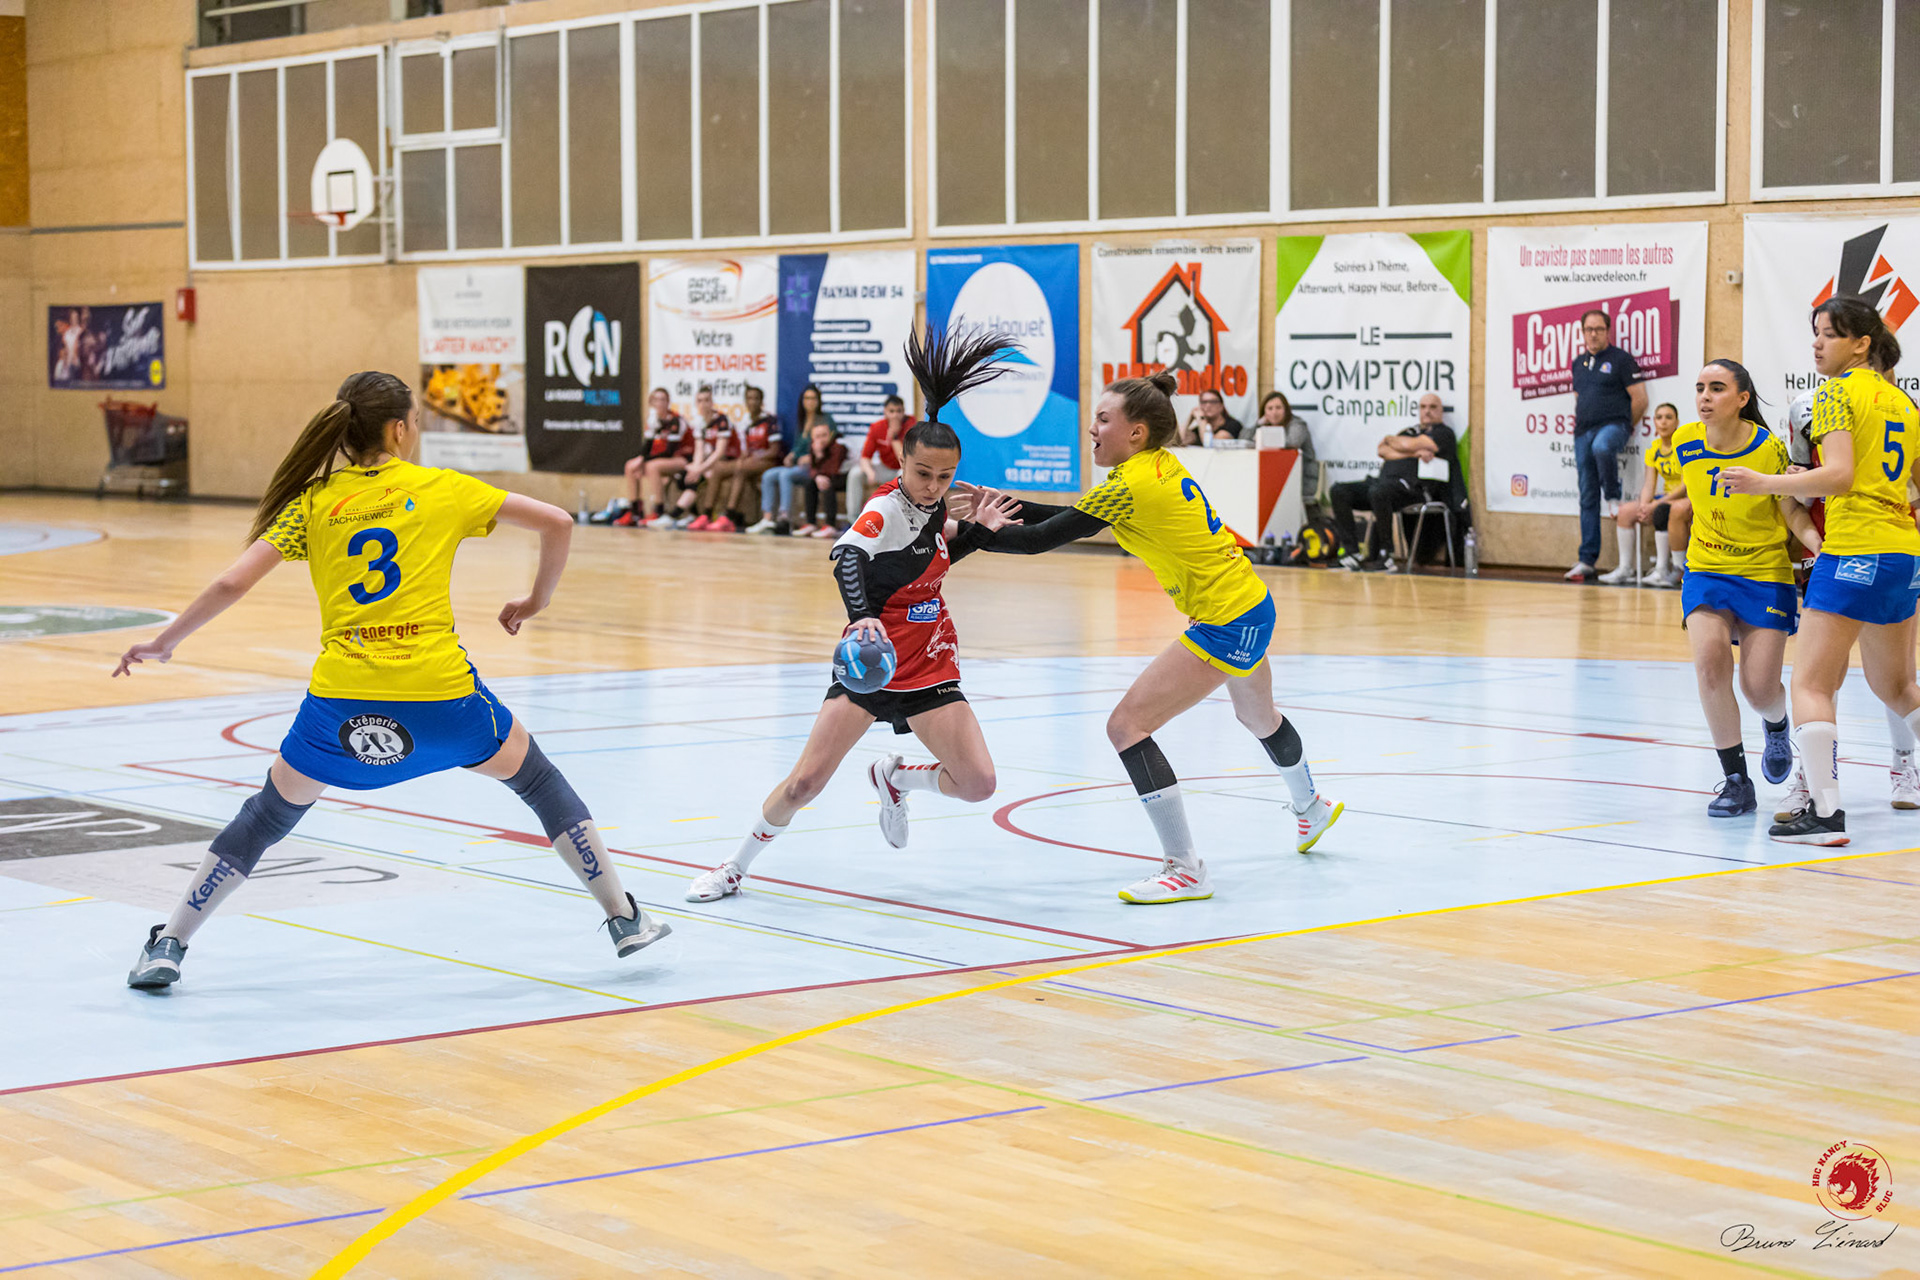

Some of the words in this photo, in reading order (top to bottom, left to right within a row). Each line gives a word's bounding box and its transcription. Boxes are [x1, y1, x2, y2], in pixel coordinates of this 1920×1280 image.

[1097, 247, 1153, 257] Construisons
[1154, 246, 1197, 256] ensemble
[1199, 246, 1222, 255] votre
[1224, 244, 1254, 254] avenir
[1520, 245, 1532, 268] Un
[1535, 244, 1568, 267] caviste
[1570, 247, 1587, 269] pas
[1590, 246, 1623, 265] comme
[1625, 244, 1641, 265] les
[1642, 243, 1673, 265] autres
[1333, 261, 1366, 273] Soirées
[1369, 261, 1375, 272] à
[1543, 270, 1648, 284] www.lacavedeleon.fr
[1297, 284, 1346, 295] Afterwork,
[1348, 283, 1378, 295] Happy
[1380, 283, 1405, 294] Hour,
[692, 329, 733, 347] Votre
[1360, 326, 1381, 346] LE
[544, 305, 622, 388] RCN
[662, 353, 767, 372] PARTENAIRE
[1290, 359, 1455, 391] COMPTOIR
[1785, 372, 1828, 390] Hello
[1322, 394, 1419, 424] Campanile
[1526, 414, 1548, 434] 03
[1555, 414, 1576, 434] 83
[1682, 447, 1703, 458] Kempa
[1882, 420, 1905, 482] 5
[1181, 477, 1223, 535] 2
[328, 510, 394, 526] ZACHAREWICZ
[935, 532, 948, 560] 9
[347, 527, 402, 605] 3
[1766, 606, 1788, 618] Kempa
[348, 715, 398, 730] Crêperie
[355, 752, 405, 766] moderne
[566, 822, 603, 882] Kemp
[187, 858, 237, 912] Kemp
